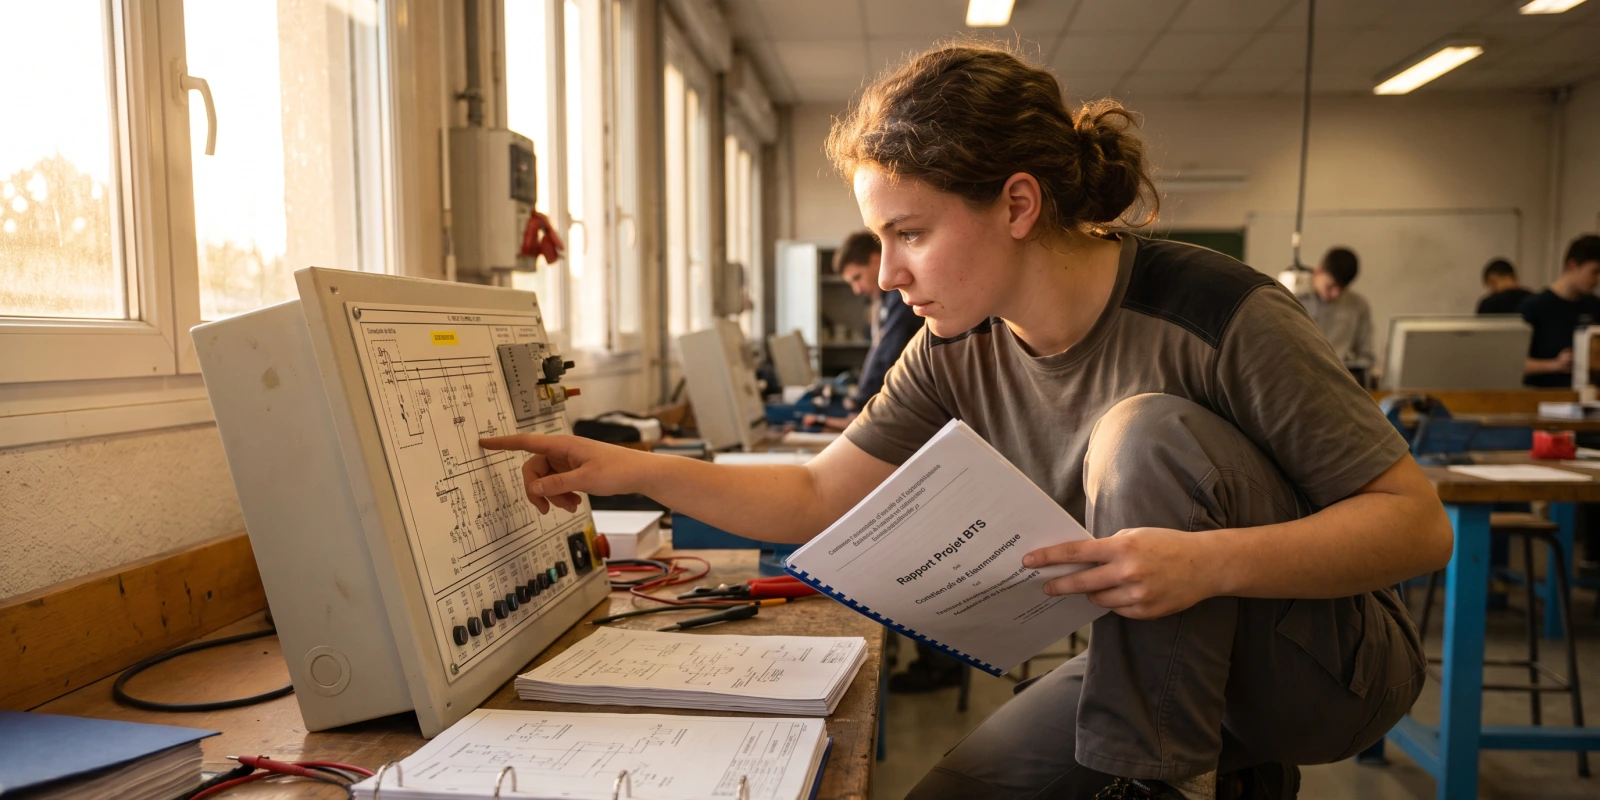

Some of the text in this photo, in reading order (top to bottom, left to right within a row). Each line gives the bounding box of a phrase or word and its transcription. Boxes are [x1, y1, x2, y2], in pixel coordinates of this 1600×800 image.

[896, 519, 987, 585] Rapport Projet BTS
